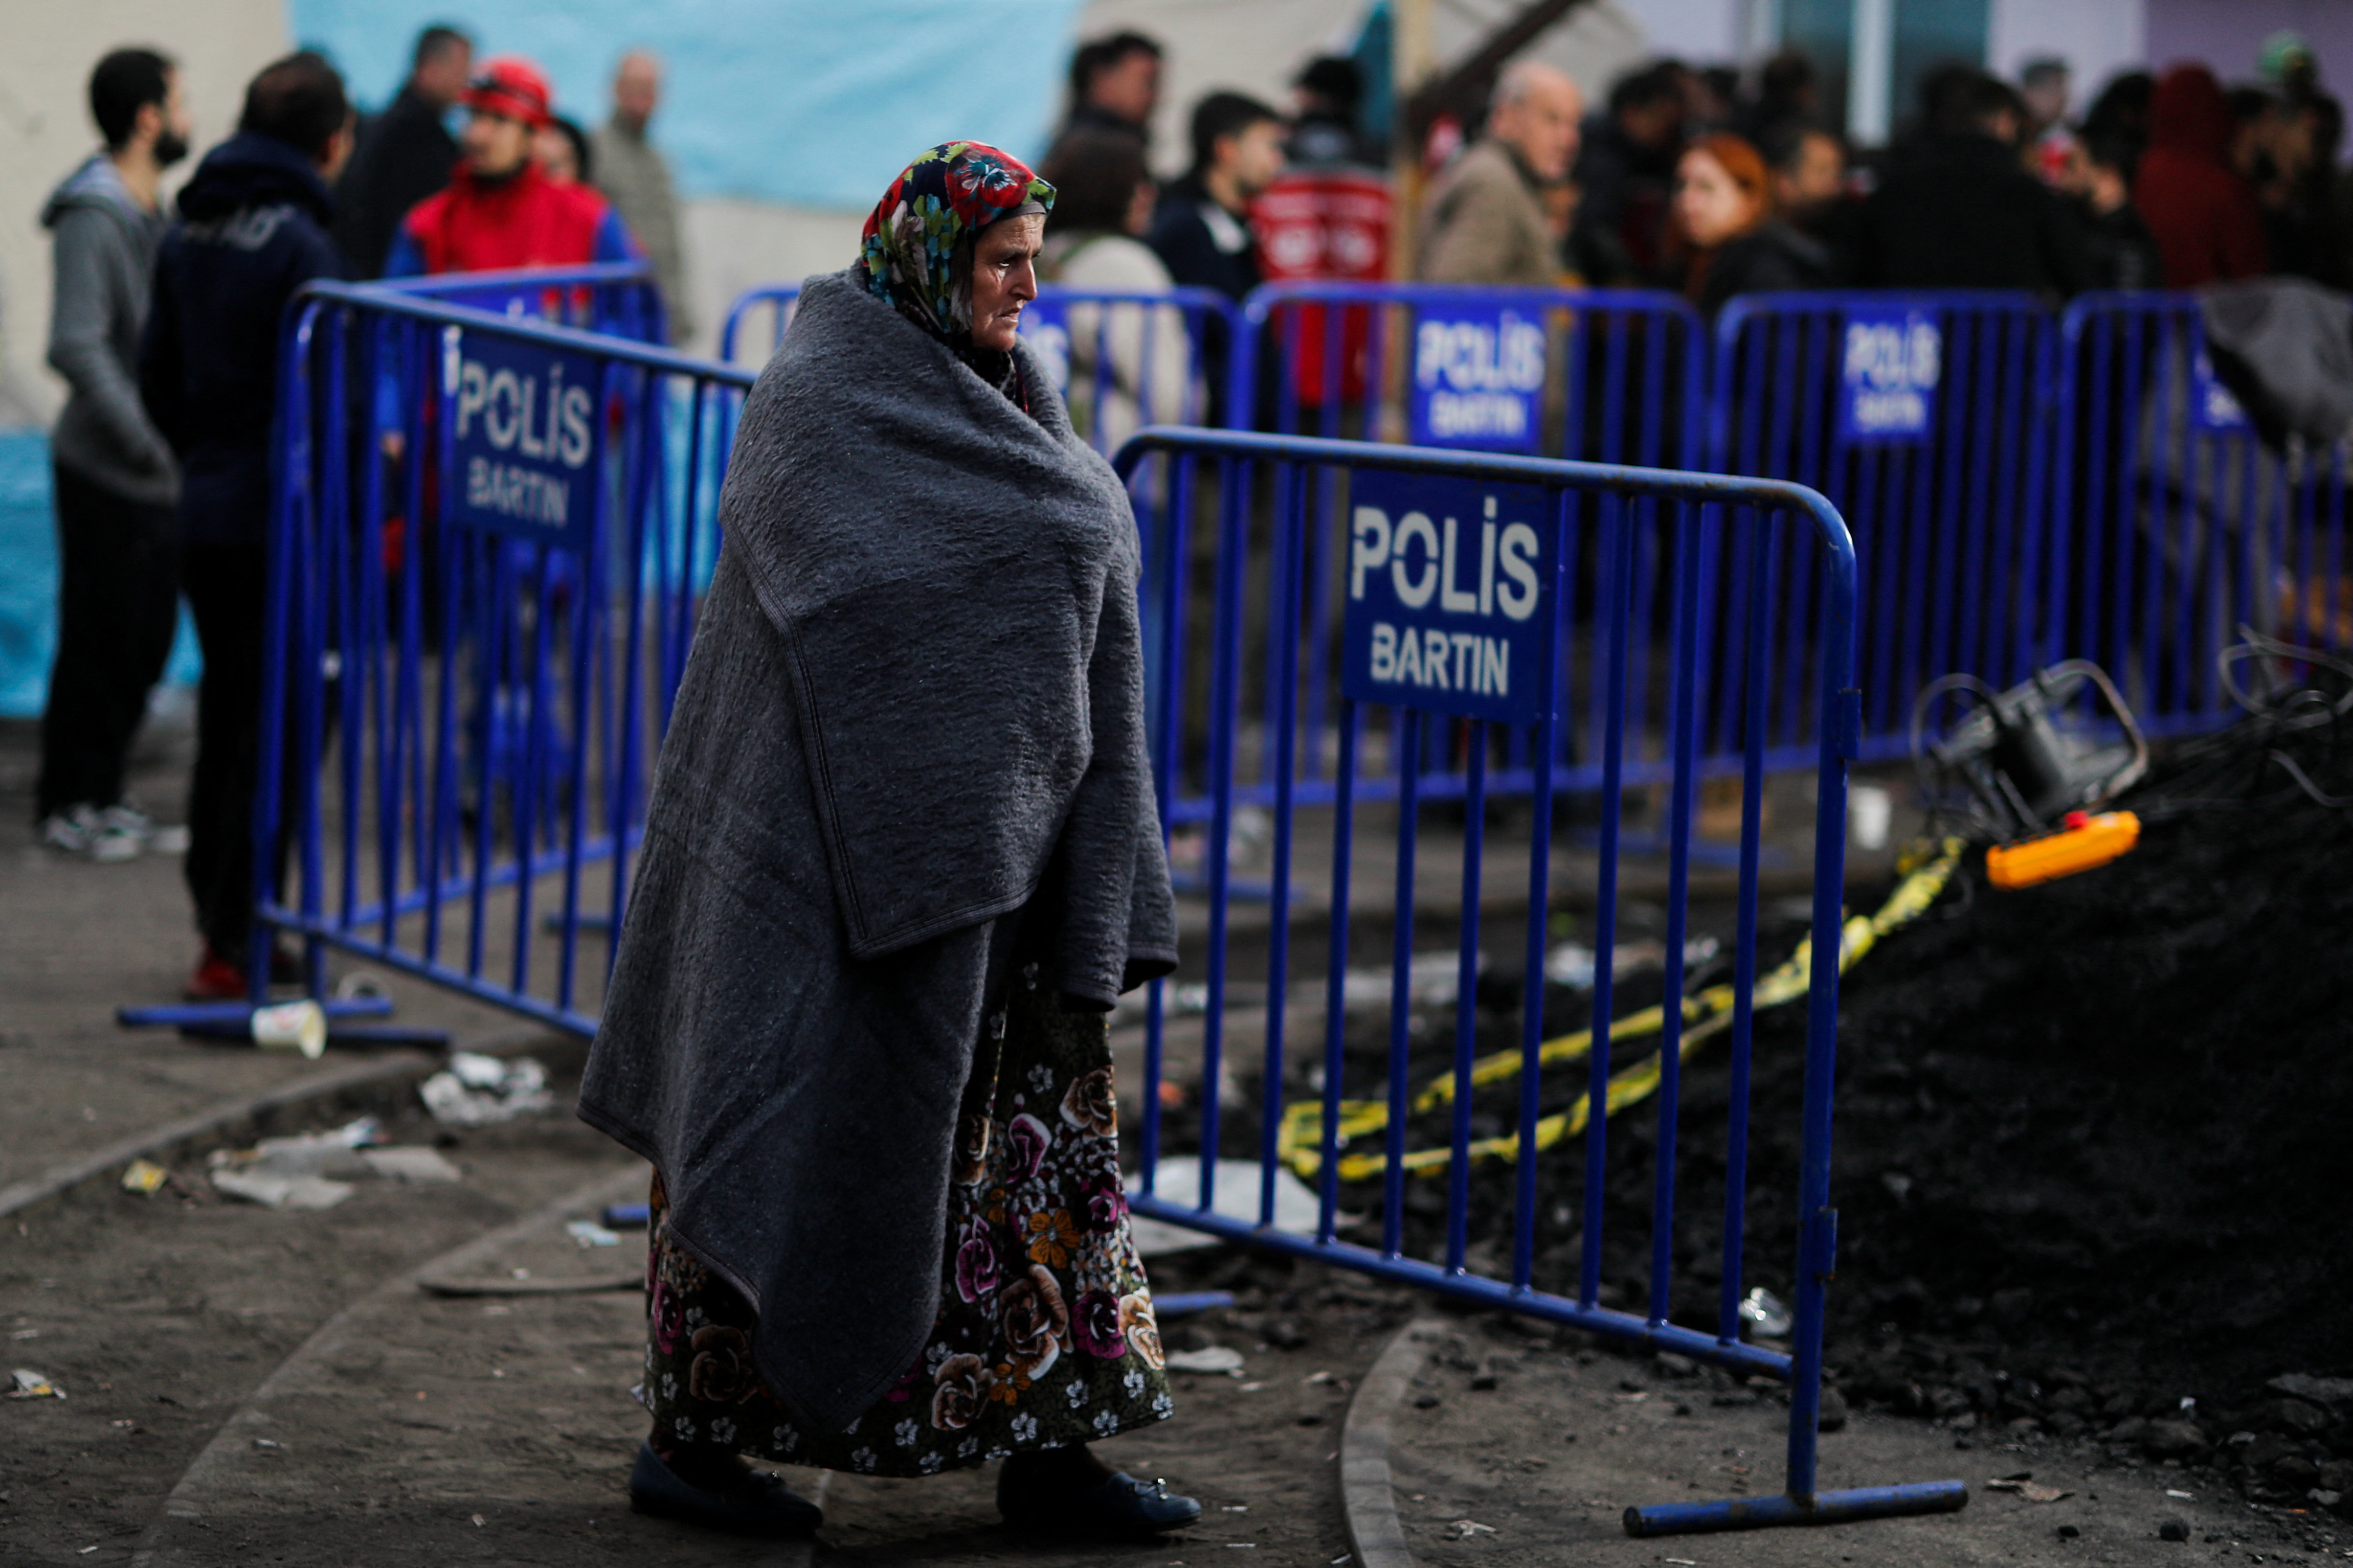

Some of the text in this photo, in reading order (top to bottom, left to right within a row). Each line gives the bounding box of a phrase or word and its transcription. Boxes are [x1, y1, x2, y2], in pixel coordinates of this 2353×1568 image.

[1418, 310, 1544, 391] POLİS
[458, 362, 591, 467] POLİS
[468, 458, 567, 525] BARTIN
[1352, 496, 1538, 620] POLİS
[1372, 624, 1509, 696] BARTIN
